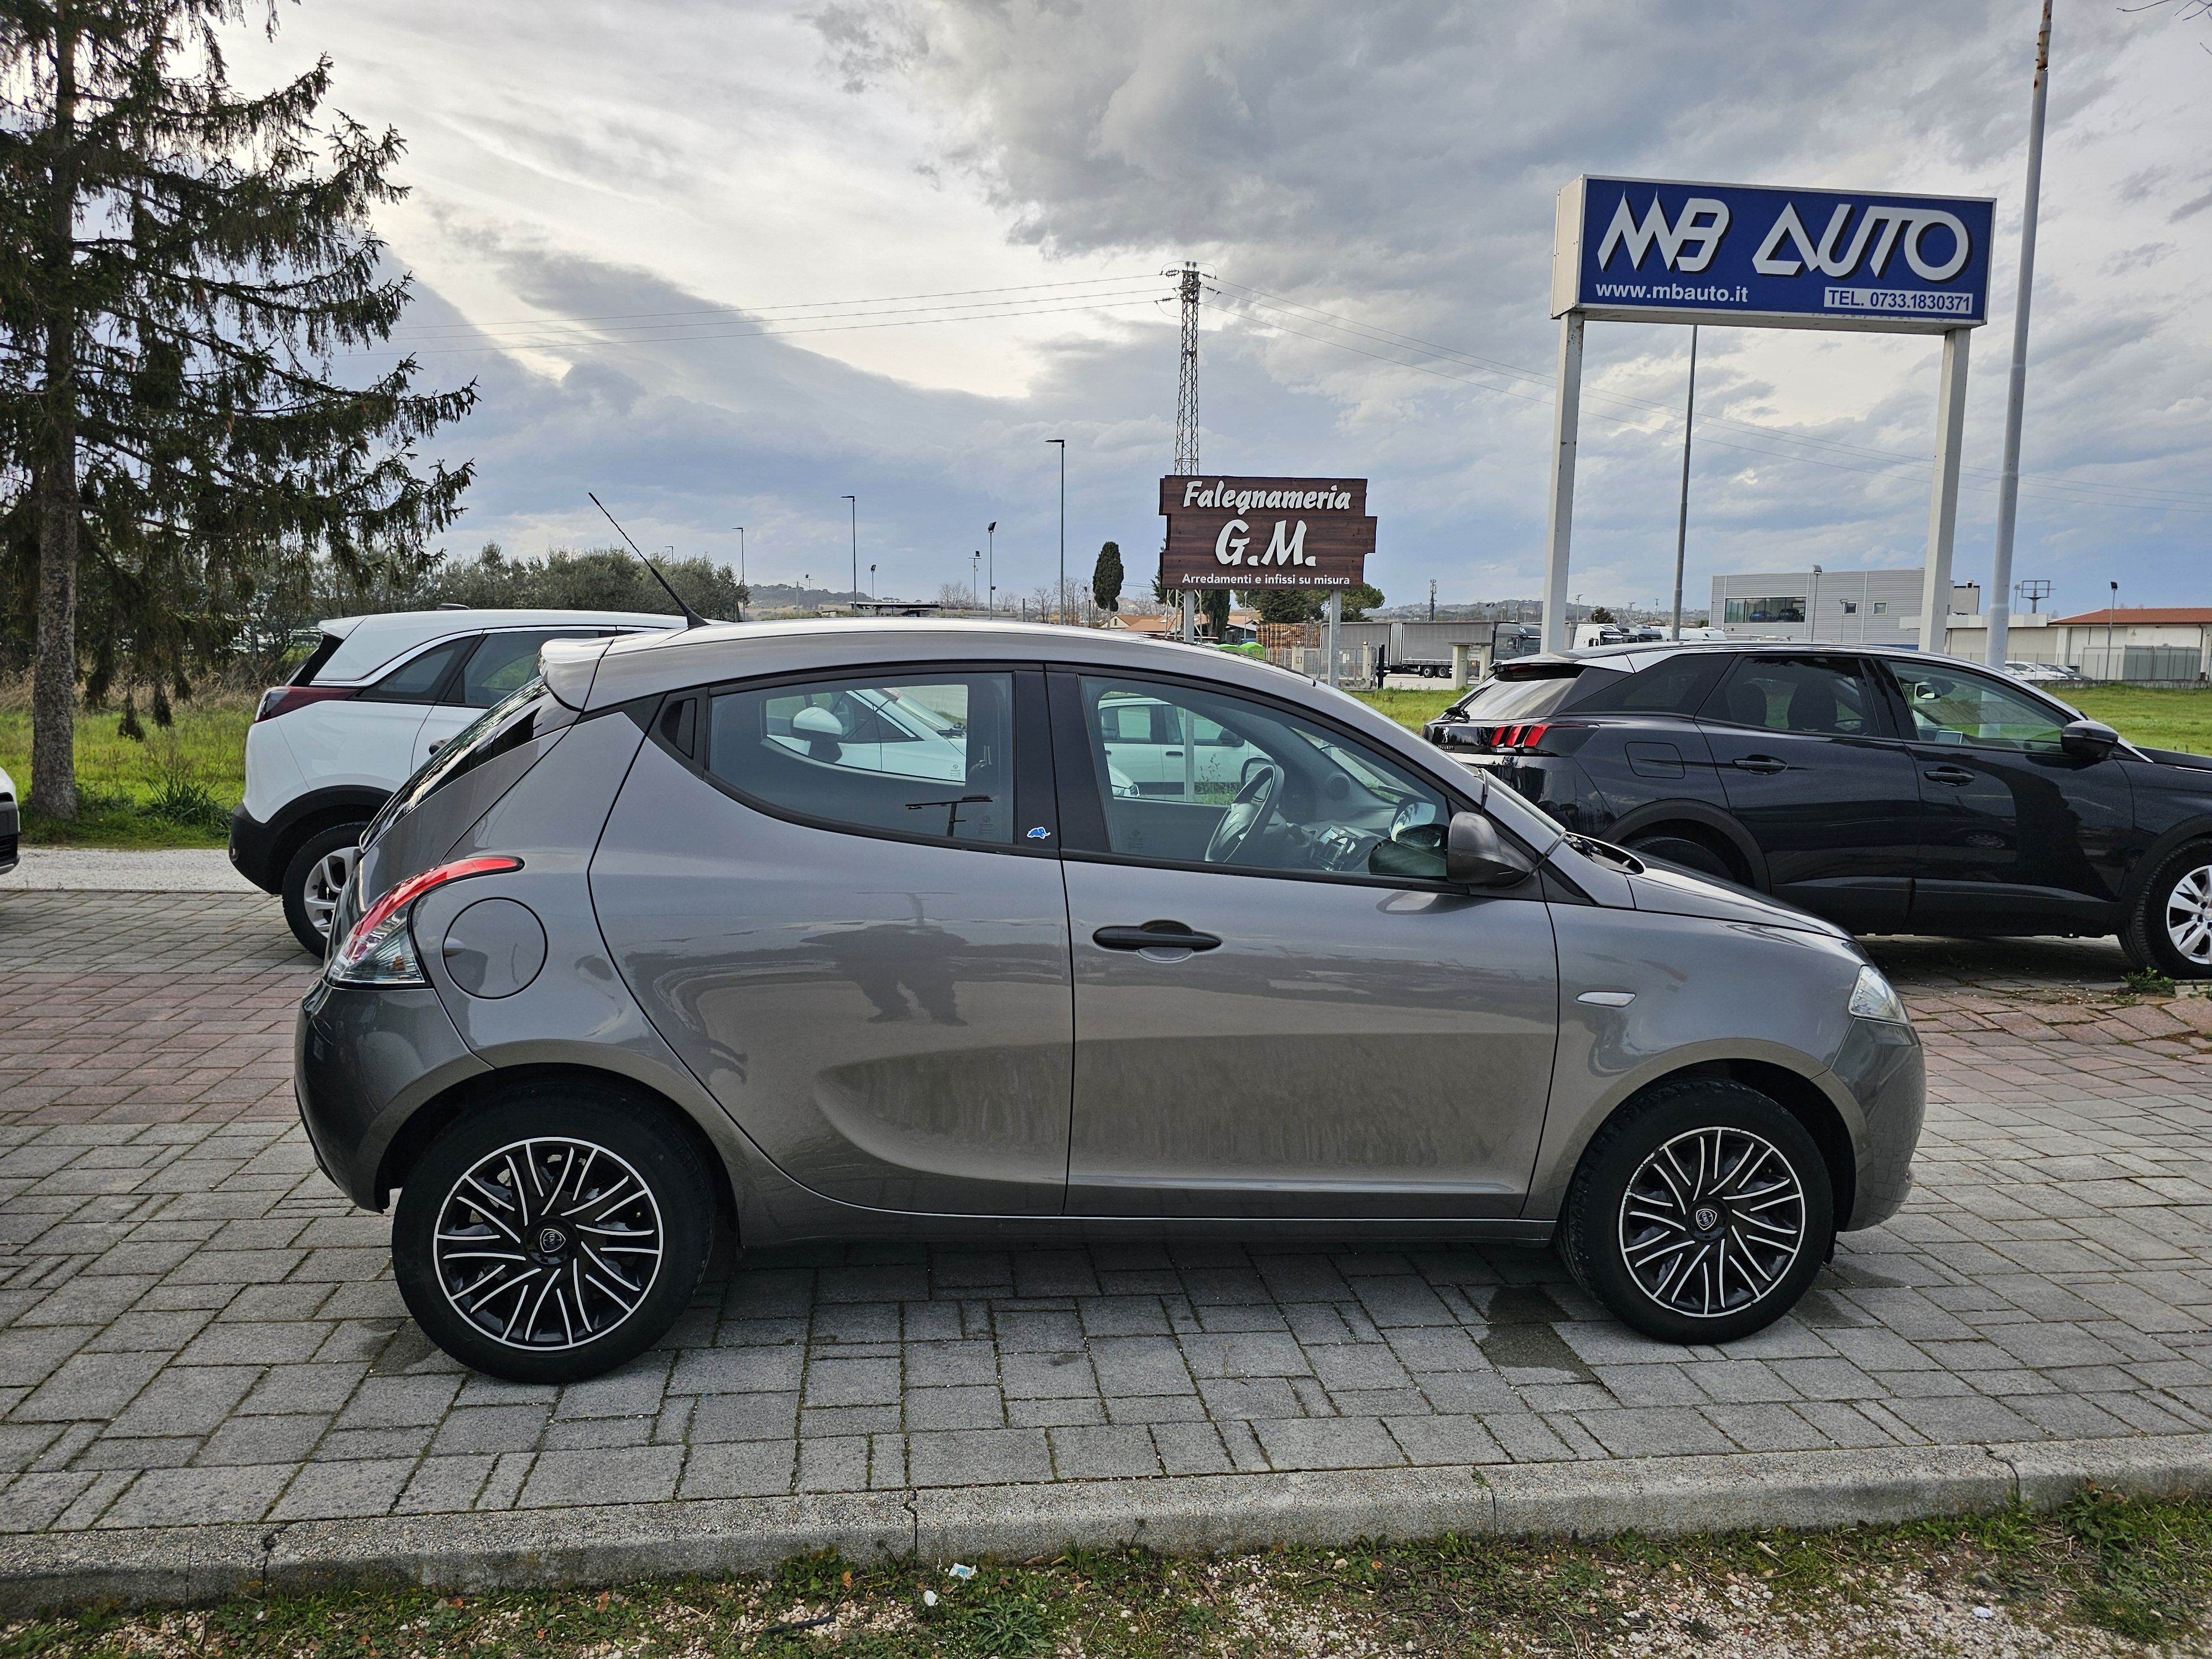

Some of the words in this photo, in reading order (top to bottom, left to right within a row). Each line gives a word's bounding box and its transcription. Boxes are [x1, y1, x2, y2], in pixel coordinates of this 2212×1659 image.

[1597, 188, 1731, 274] MB
[1751, 201, 1970, 281] AUTO
[1595, 283, 1749, 304] www.mbauto.it
[1828, 289, 1864, 307] TEL.
[1870, 291, 1972, 311] 0733.1830371
[1183, 480, 1352, 515] Falegnameria
[1215, 519, 1316, 566] G.M.
[1182, 573, 1251, 585] Arredamenti
[1265, 574, 1295, 585] infissi
[1314, 575, 1350, 585] misura
